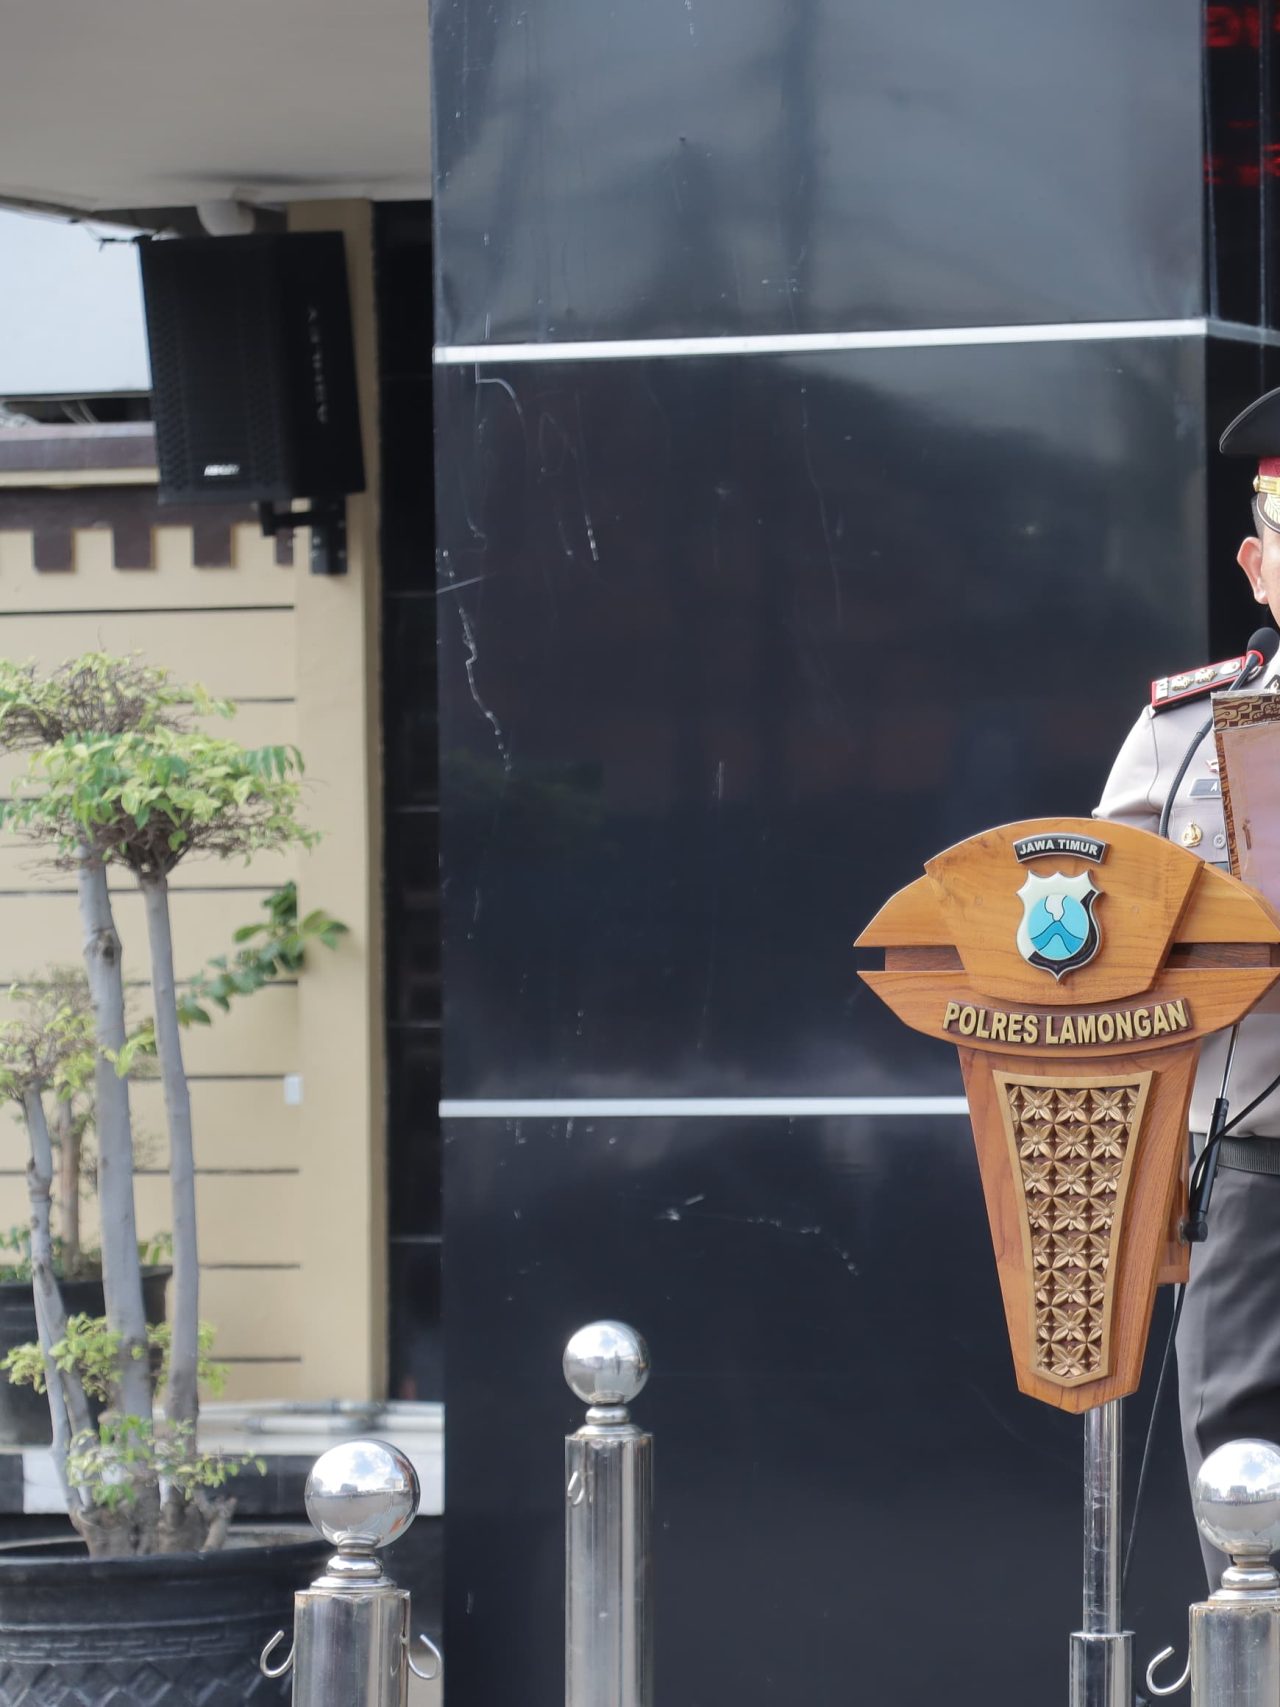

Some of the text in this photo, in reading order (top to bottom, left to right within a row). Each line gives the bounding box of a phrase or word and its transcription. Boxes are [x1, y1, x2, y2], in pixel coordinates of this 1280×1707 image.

[1020, 839, 1098, 855] JAWA TIMUR
[943, 1000, 1188, 1044] POLRES LAMONGAN
